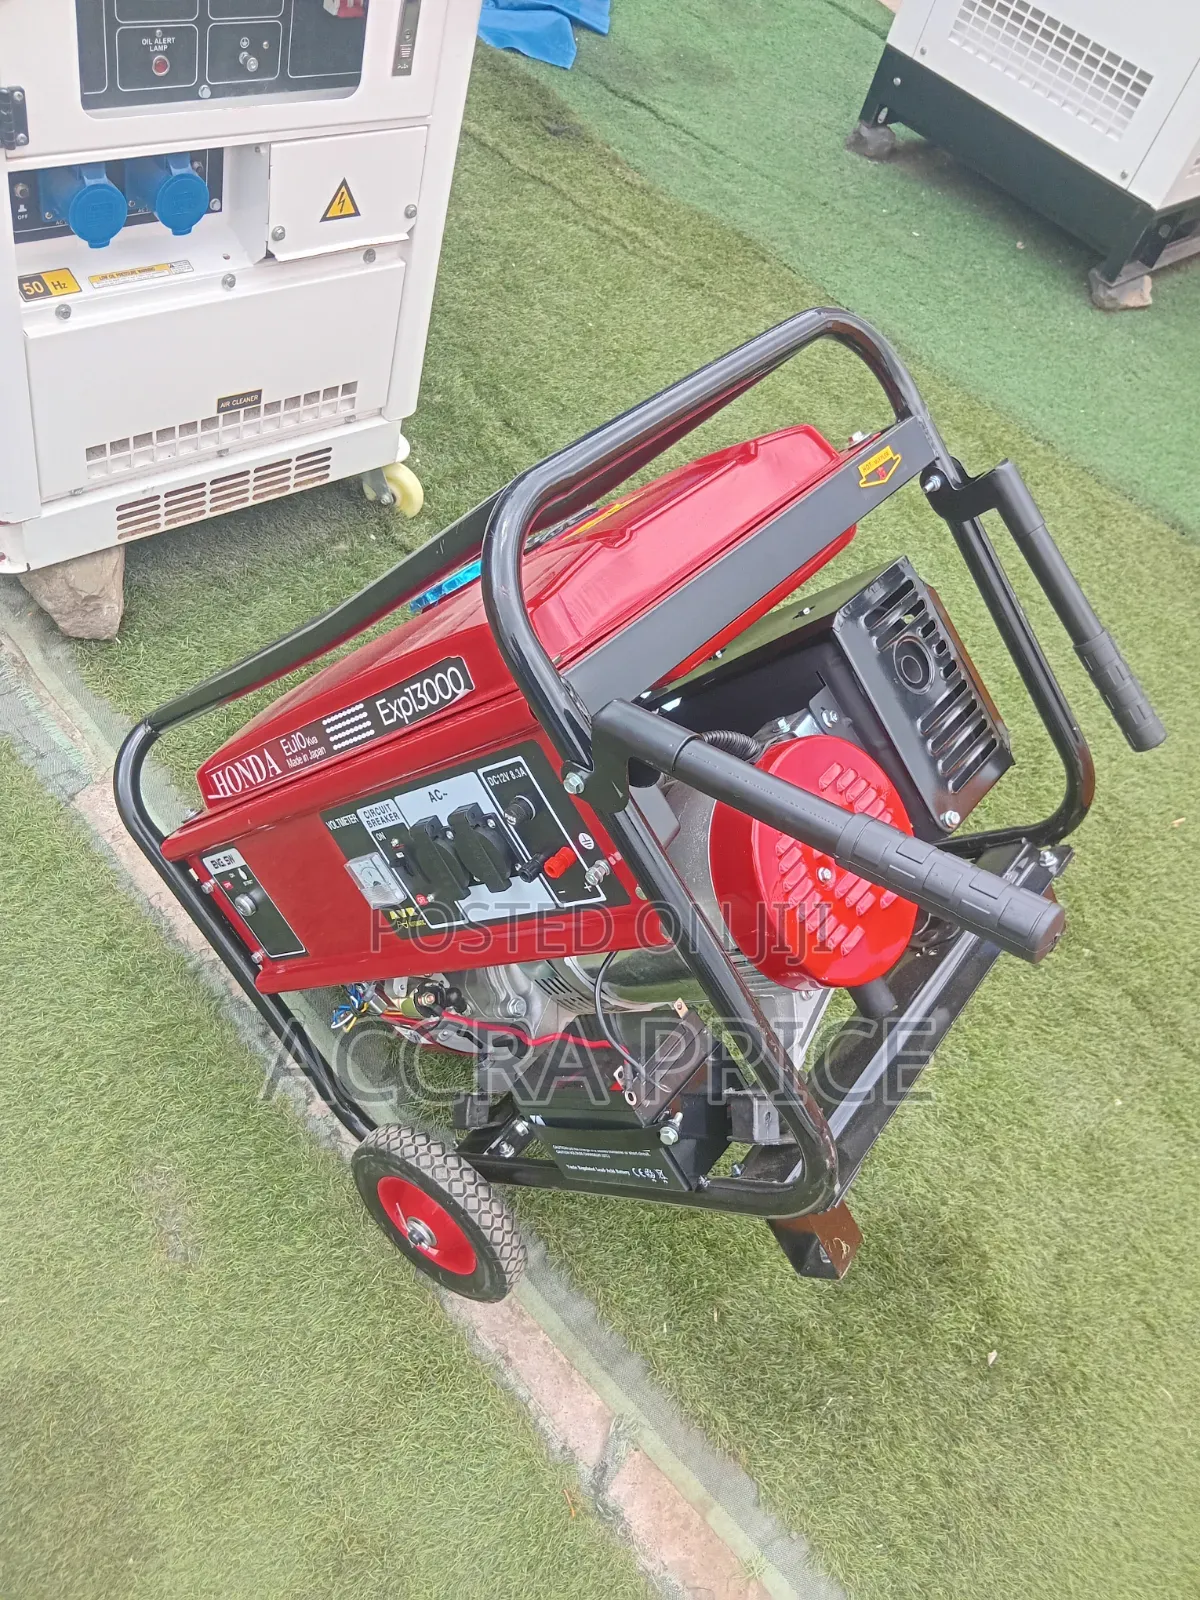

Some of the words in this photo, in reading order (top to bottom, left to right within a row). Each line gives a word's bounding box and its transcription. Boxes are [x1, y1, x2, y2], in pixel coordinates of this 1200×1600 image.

[141, 38, 153, 46] OIL
[154, 37, 176, 45] ALERT
[149, 44, 169, 52] LAMP
[23, 281, 45, 296] 50
[51, 280, 68, 291] Hz
[231, 394, 259, 406] CLEANER
[375, 666, 465, 725] Exp13000
[286, 755, 304, 769] Made
[308, 746, 327, 760] Japan
[210, 748, 283, 797] HONDA
[487, 771, 511, 787] DC12V
[509, 766, 528, 780] 8.3A
[363, 803, 392, 820] CIRCUIT
[325, 812, 361, 831] VOLTMETER
[366, 812, 401, 829] BREAKER
[375, 831, 388, 842] ON
